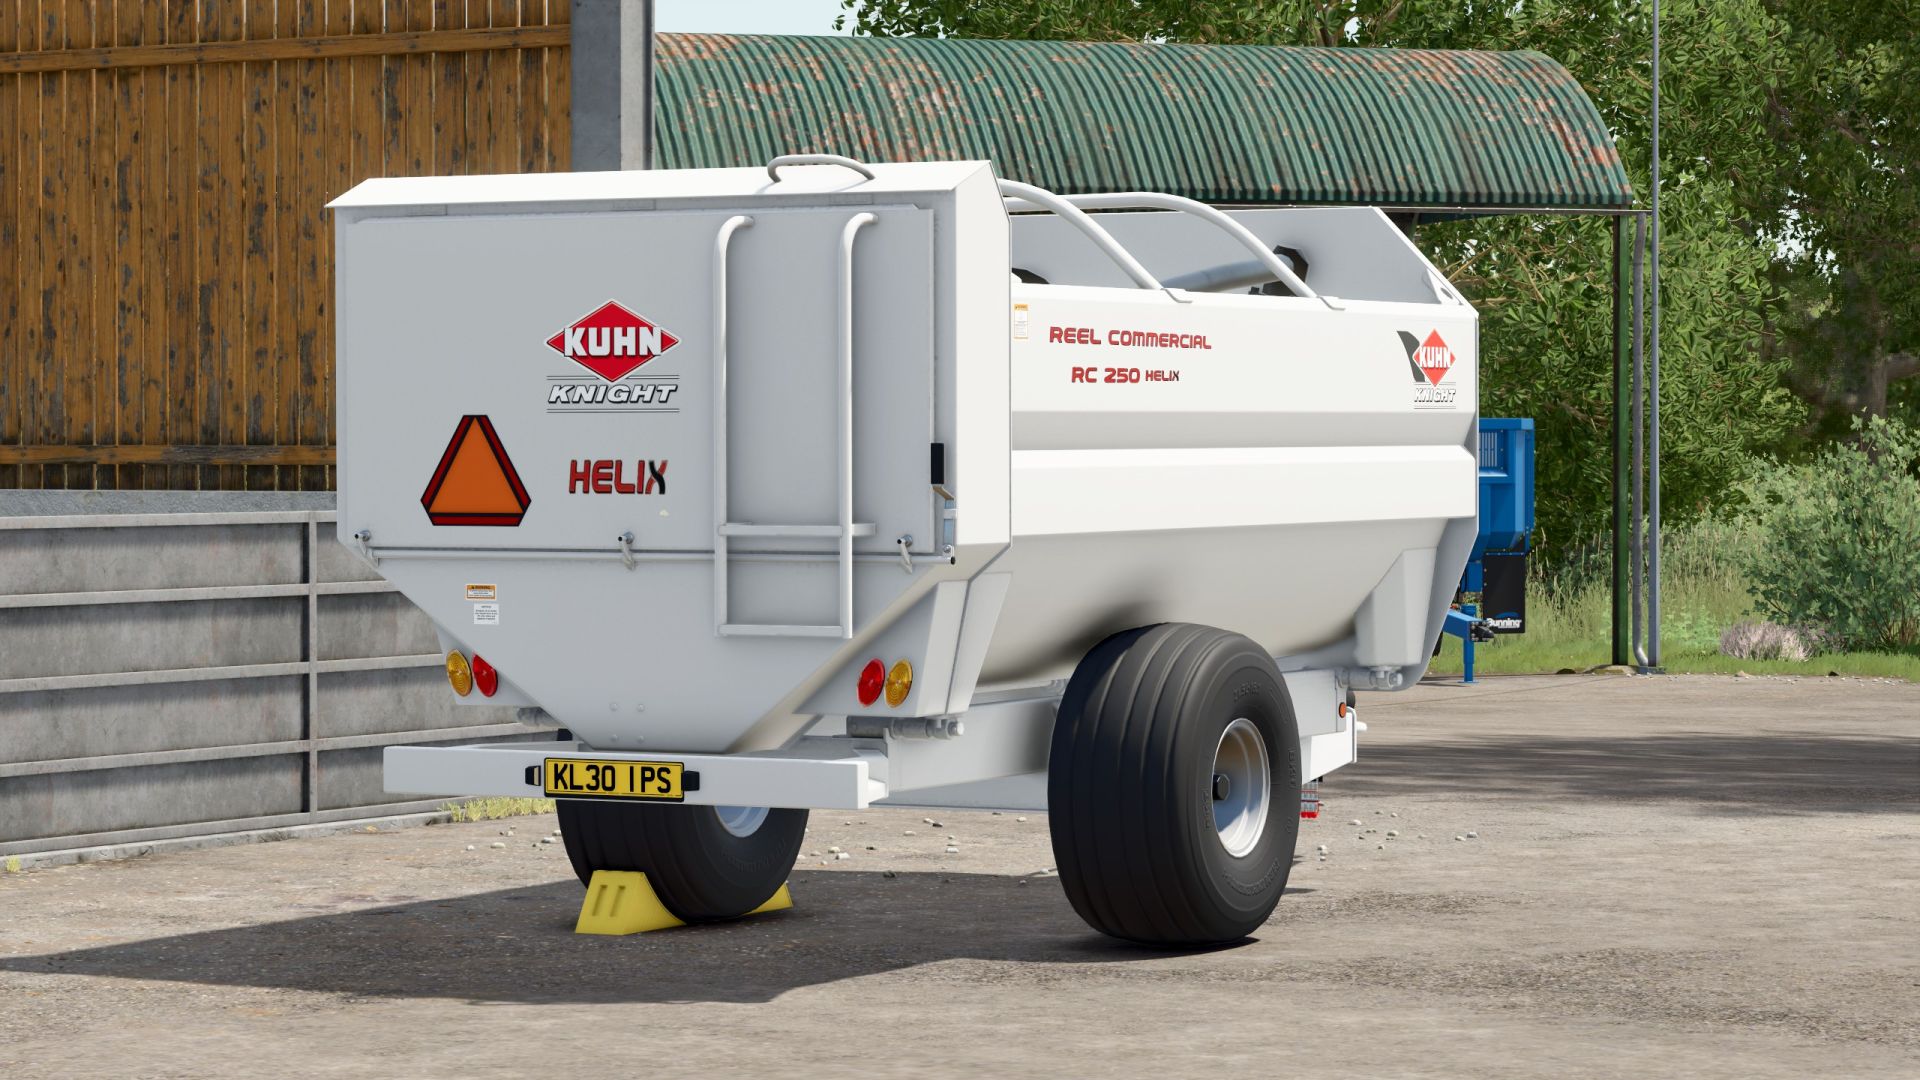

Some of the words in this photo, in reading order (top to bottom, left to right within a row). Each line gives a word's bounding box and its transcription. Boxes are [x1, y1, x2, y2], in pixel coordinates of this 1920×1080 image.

[563, 327, 663, 357] KUHN
[1049, 326, 1102, 345] REEL
[1108, 329, 1212, 350] COMMERCIAL
[1420, 346, 1451, 368] KUHN
[1071, 366, 1098, 383] RC
[1103, 367, 1141, 384] 250
[1145, 369, 1180, 382] HELIX
[548, 384, 678, 404] KNIGHT
[1414, 388, 1456, 403] KNIGHT
[569, 460, 668, 495] HELIX
[553, 763, 616, 792] KL30
